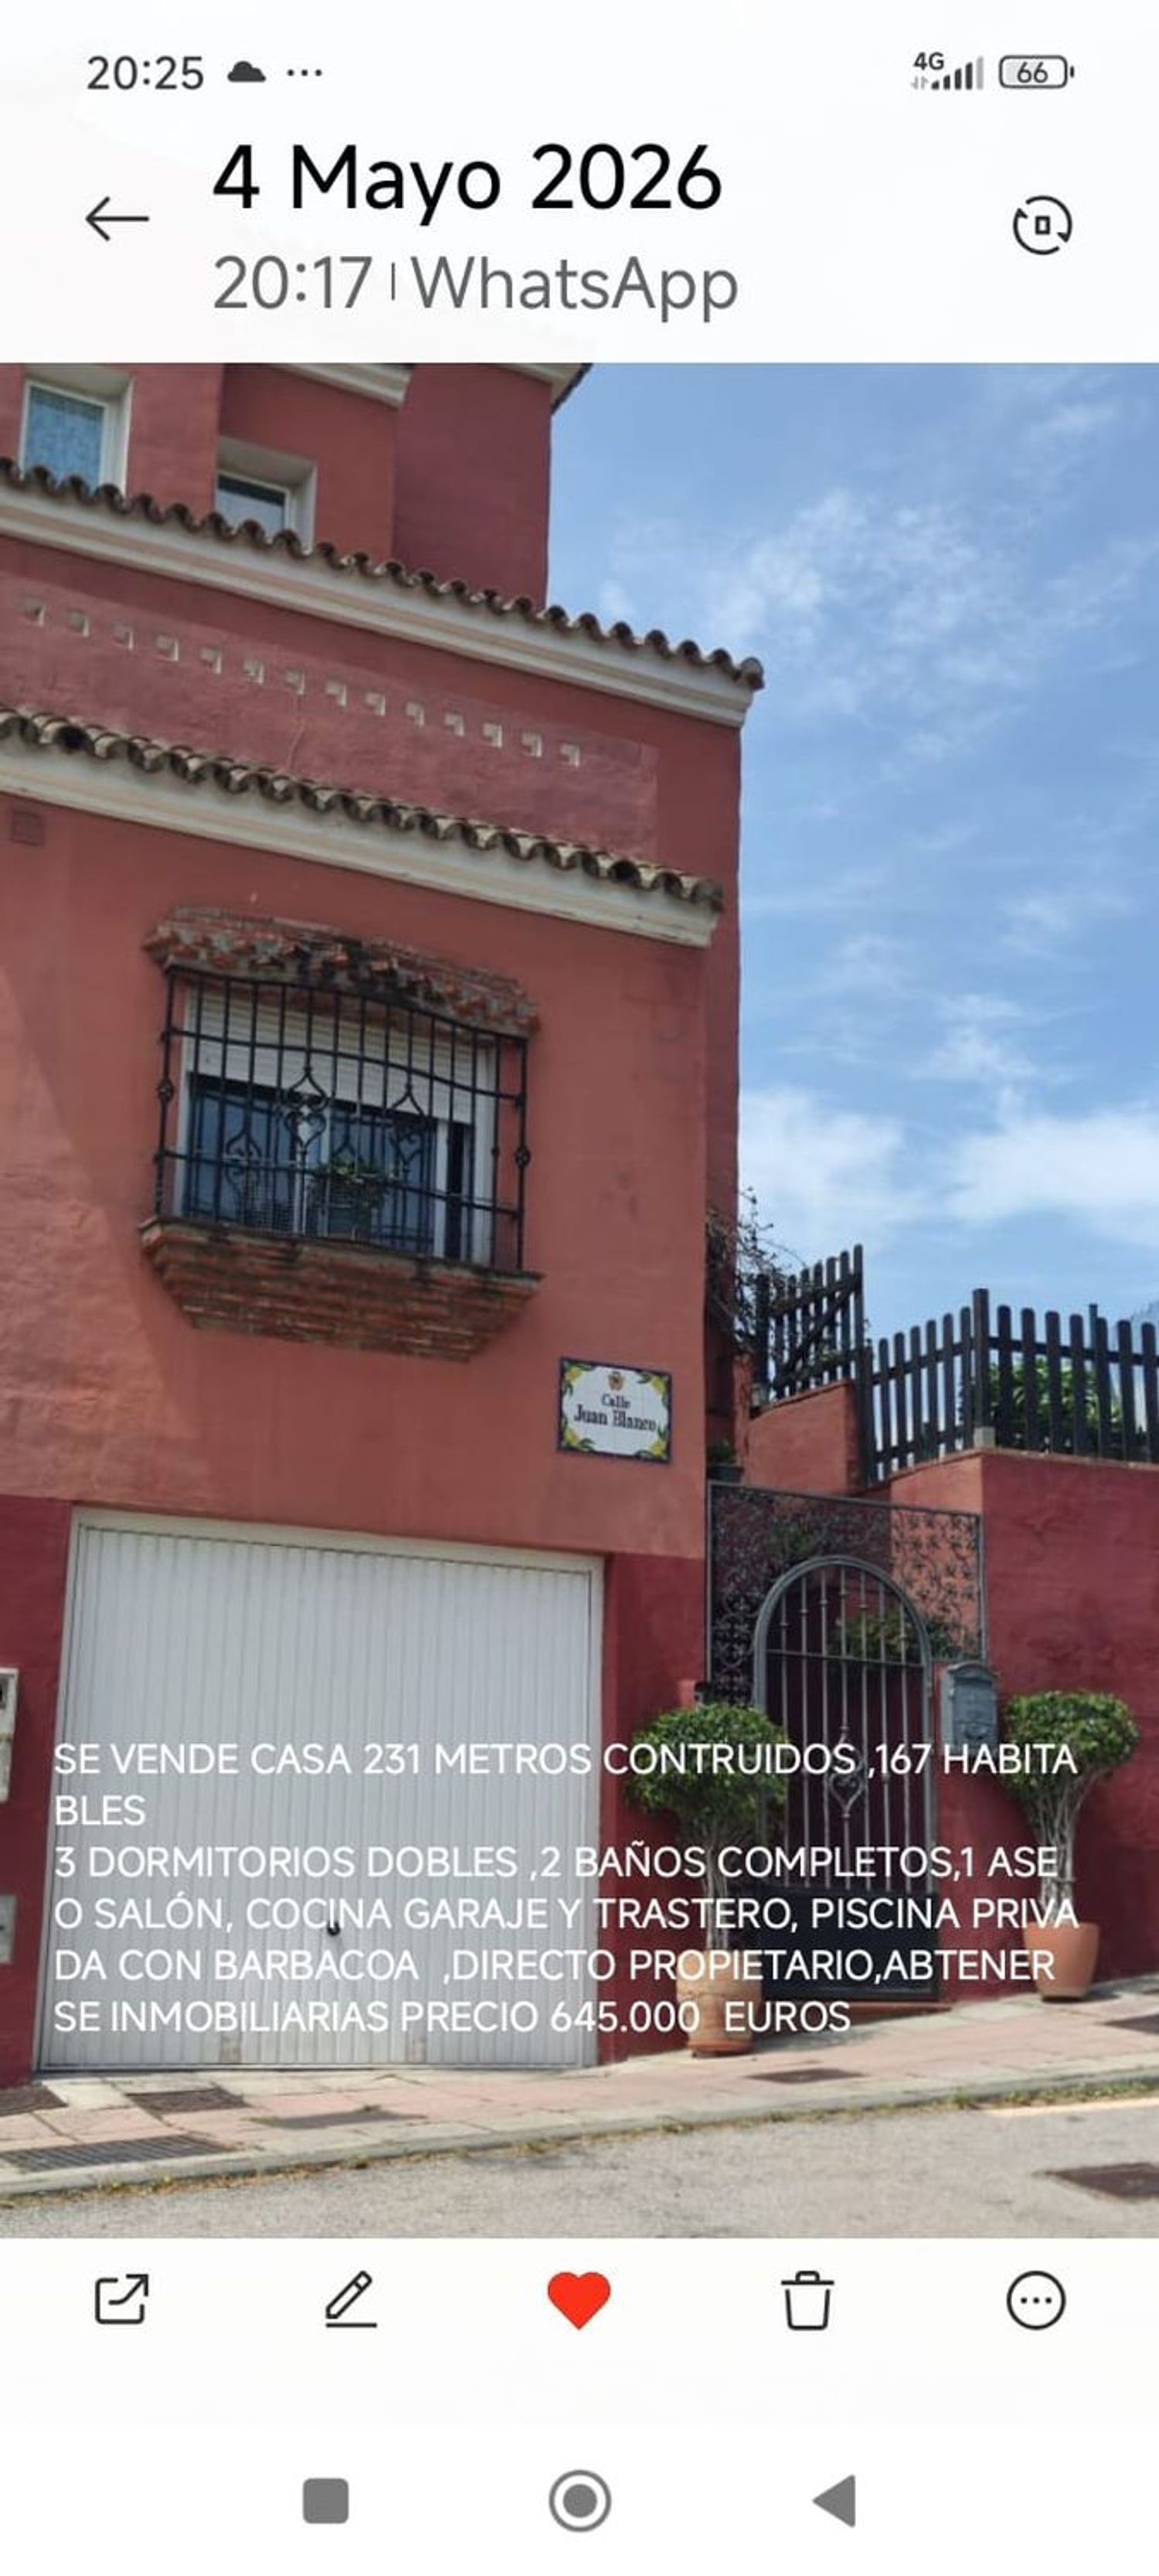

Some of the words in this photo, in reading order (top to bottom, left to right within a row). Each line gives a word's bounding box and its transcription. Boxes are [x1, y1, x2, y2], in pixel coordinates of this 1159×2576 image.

[600, 1393, 630, 1409] Calle
[574, 1404, 607, 1425] Juan
[613, 1411, 657, 1431] Blanco
